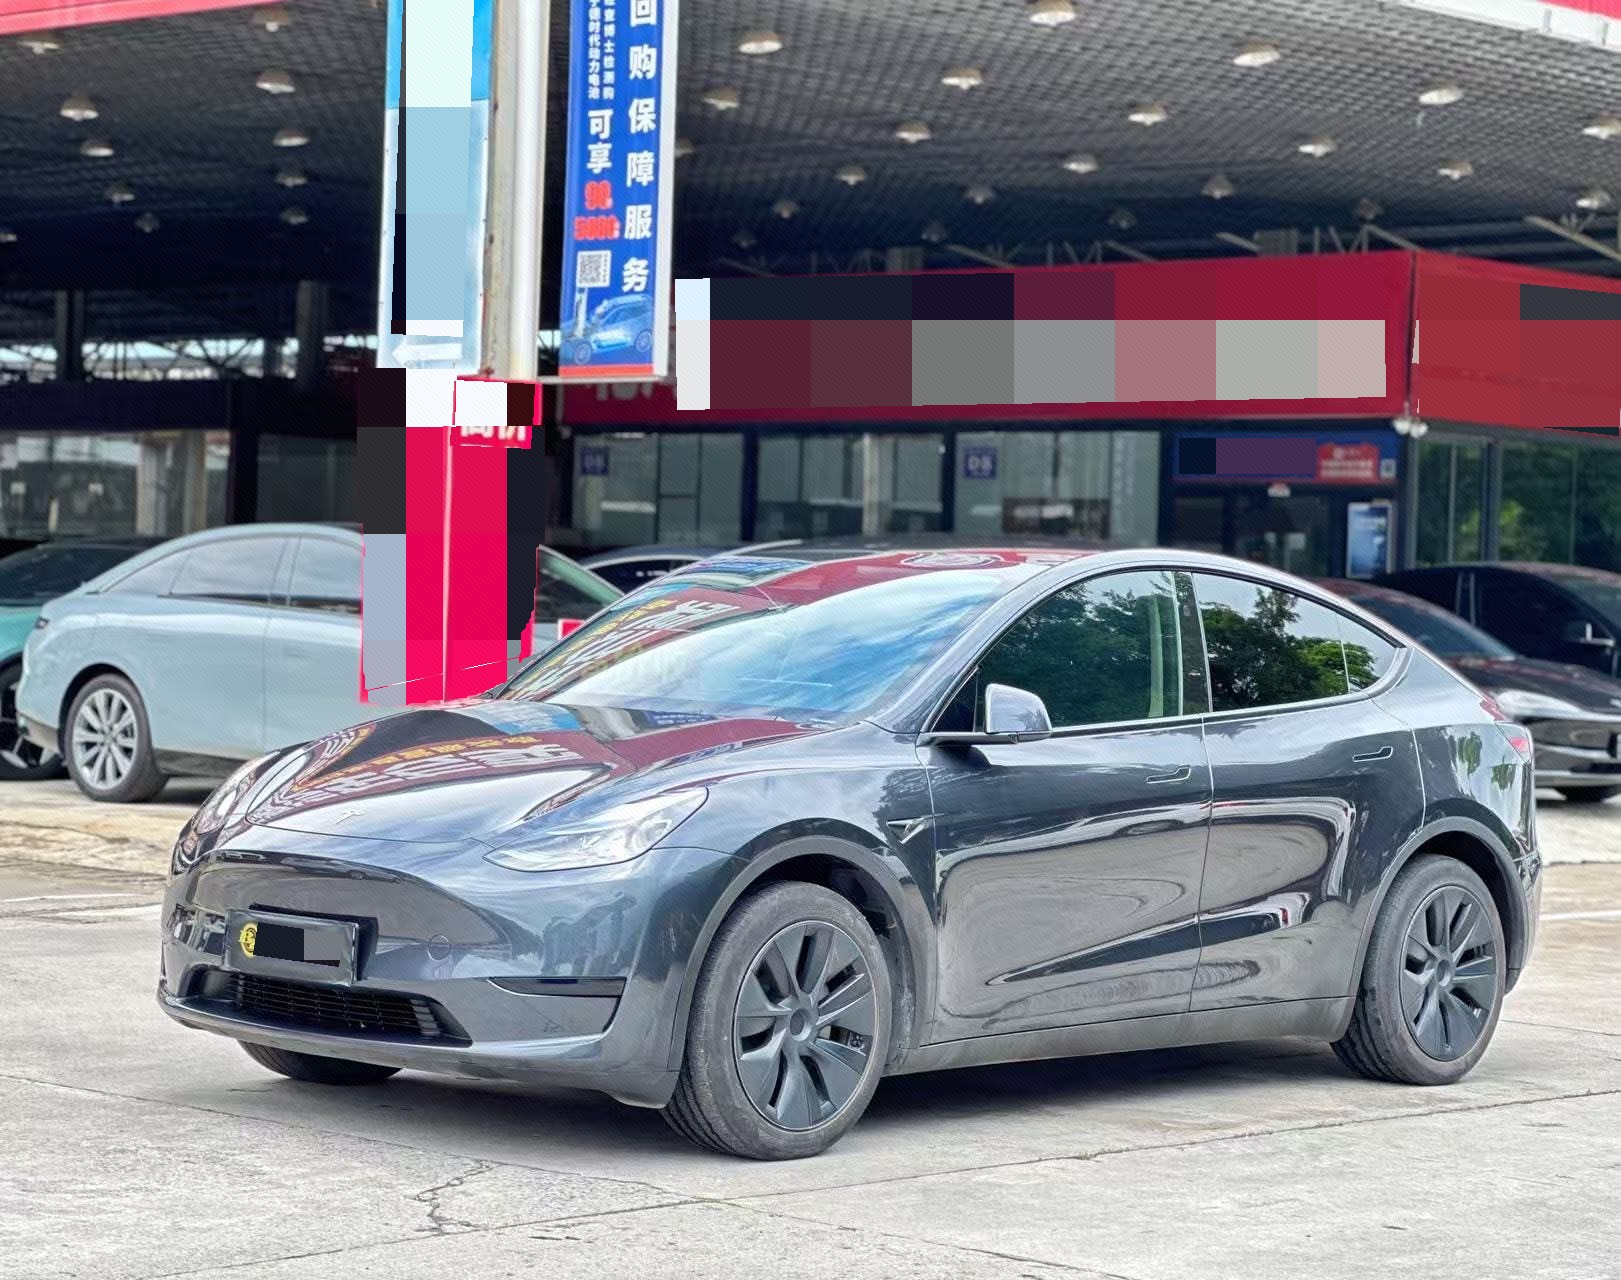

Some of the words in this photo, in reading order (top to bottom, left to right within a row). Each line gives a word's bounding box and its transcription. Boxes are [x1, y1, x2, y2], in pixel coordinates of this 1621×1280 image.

[587, 109, 614, 174] 可享
[622, 0, 657, 292] 回购保障服务
